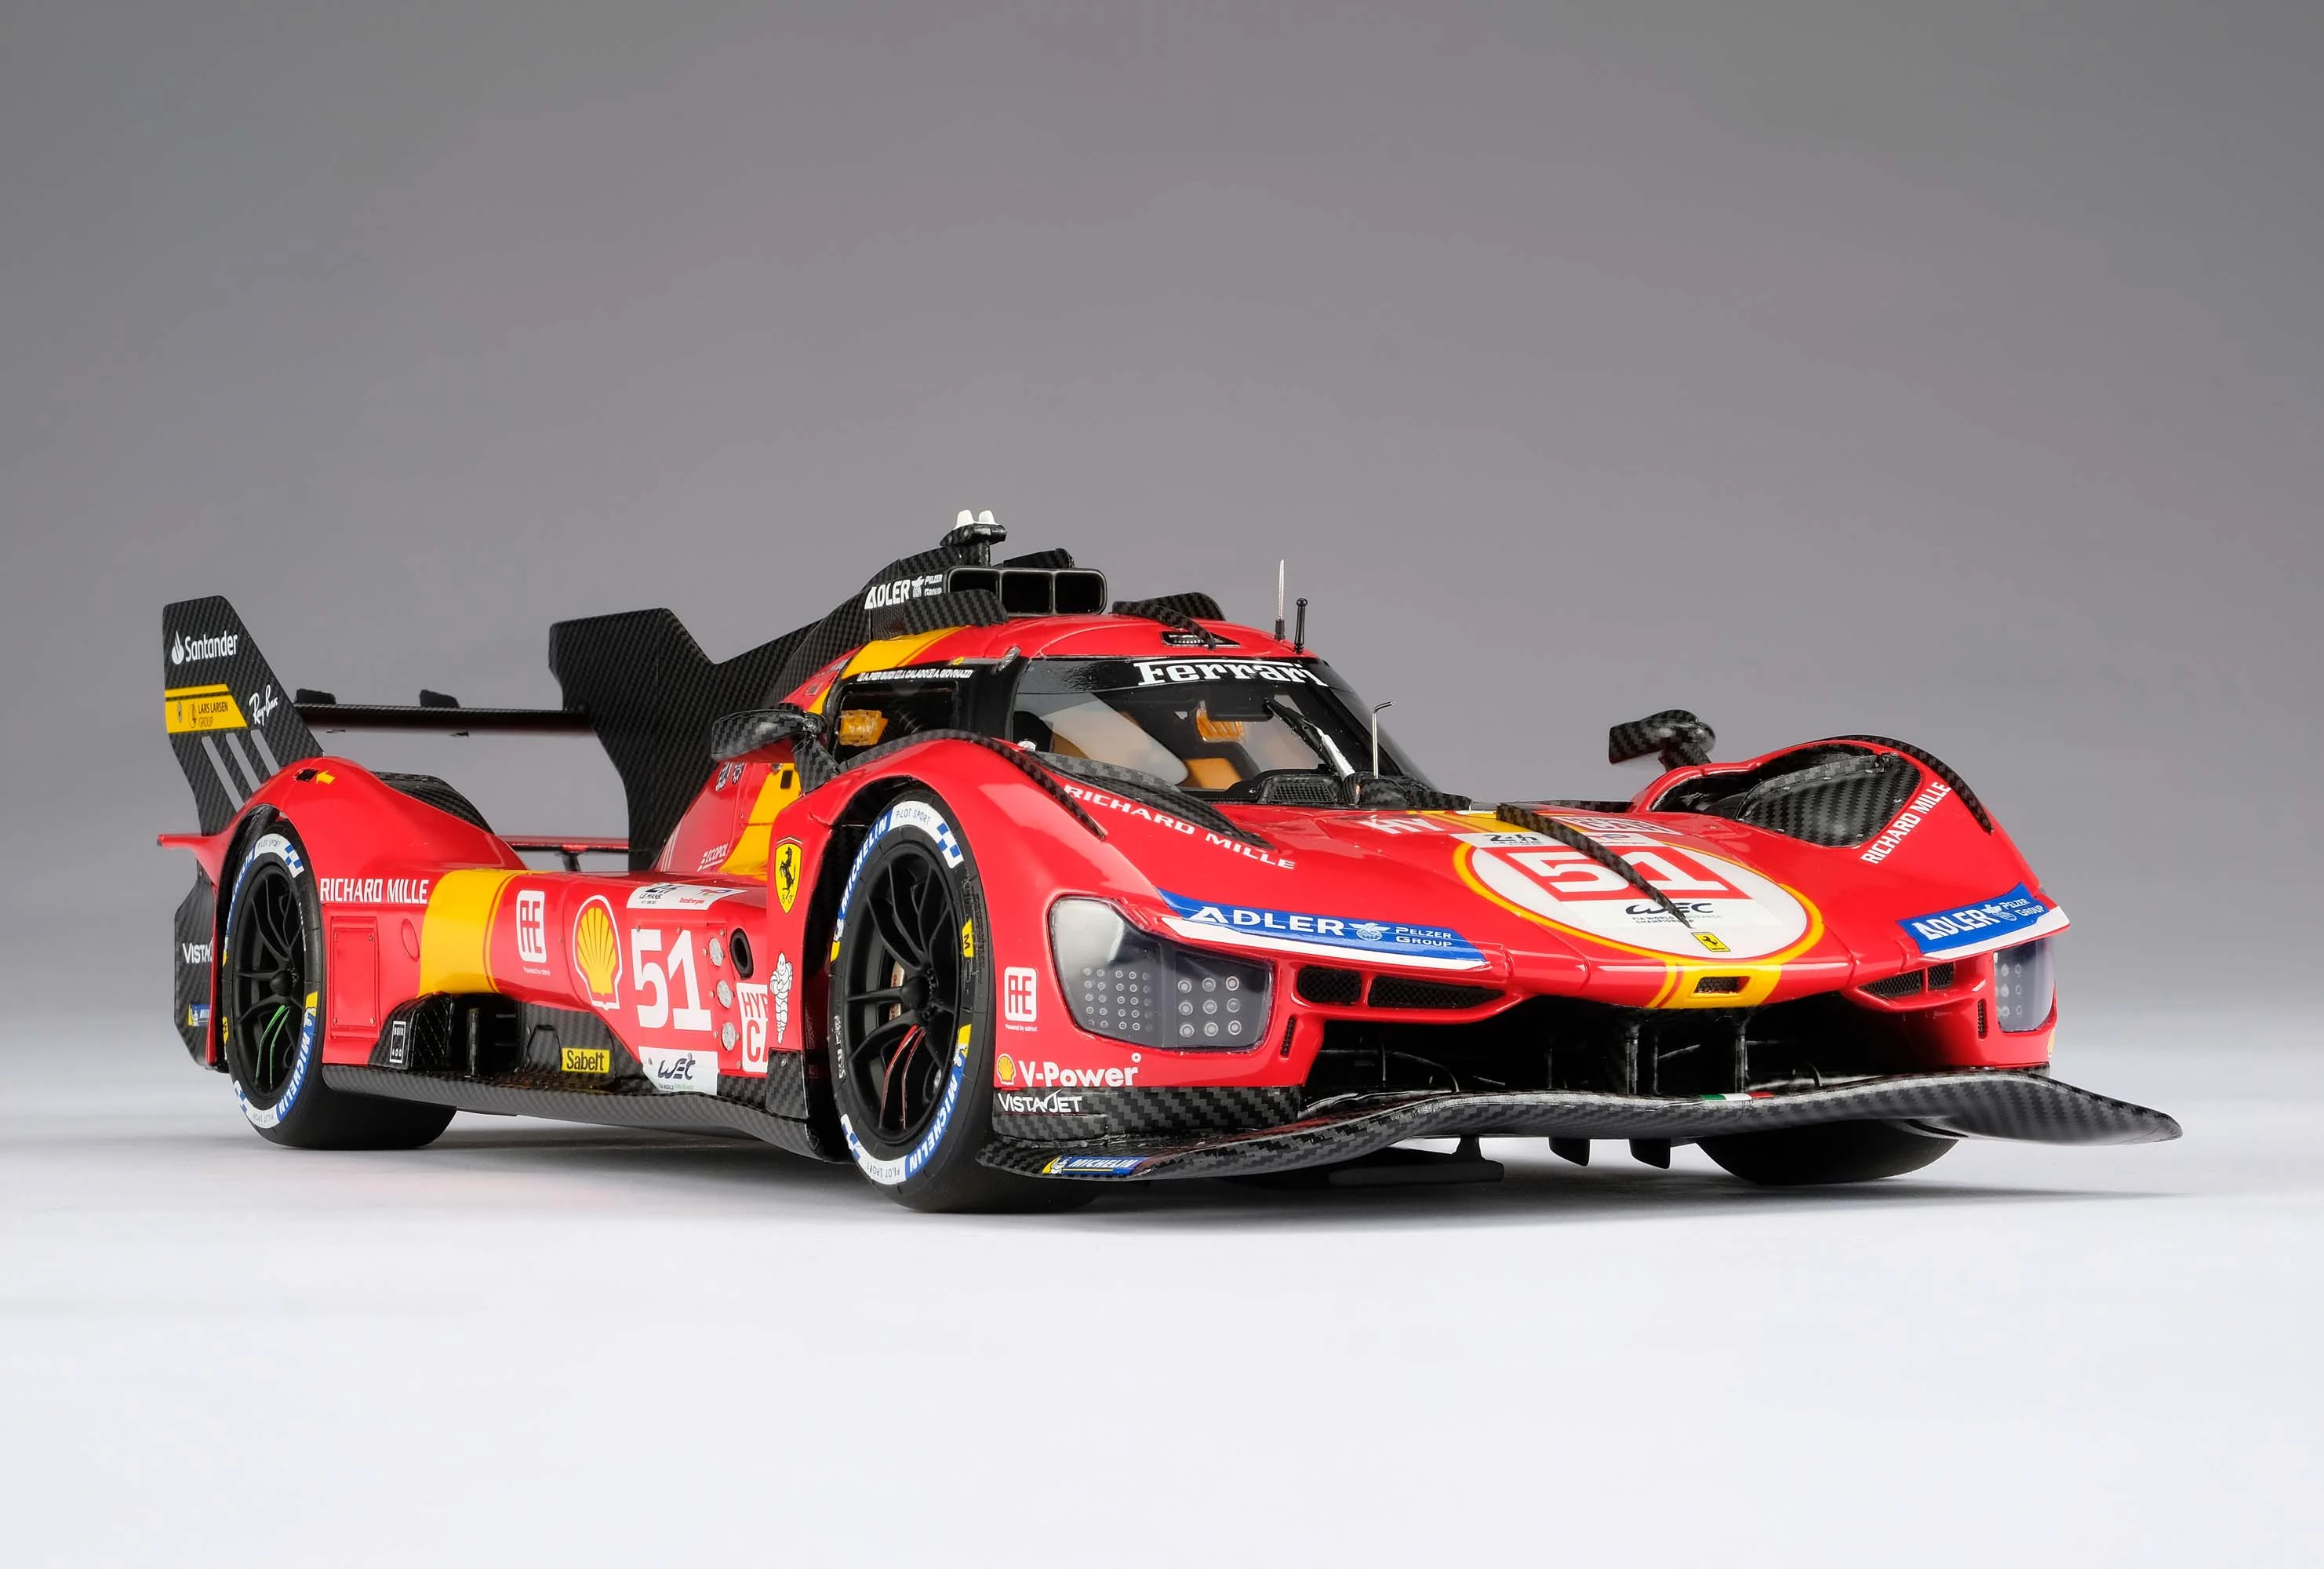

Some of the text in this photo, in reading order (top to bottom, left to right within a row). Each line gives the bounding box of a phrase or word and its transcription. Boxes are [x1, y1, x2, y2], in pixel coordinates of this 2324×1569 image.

[864, 579, 911, 610] ADLER
[184, 630, 238, 662] Santander
[1133, 658, 1329, 688] Ferrari
[198, 701, 228, 714] LARS LARSEN
[1063, 784, 1296, 870] RICHARD MILLE
[1859, 781, 1952, 865] RICHARD MILLE
[1505, 850, 1731, 893] 51
[320, 878, 430, 905] RICHARD MILLE
[1998, 897, 2031, 910] PELZER
[1188, 906, 1344, 937] ADLER
[1911, 908, 2002, 941] ADLER
[2014, 905, 2045, 916] GROUP
[1395, 926, 1452, 939] PELZER
[1395, 936, 1453, 948] GROUP
[631, 928, 712, 1032] 51
[278, 1031, 312, 1116] MICHELIN
[566, 1050, 605, 1072] Sabelt
[657, 1058, 696, 1081] WEC
[1018, 1060, 1139, 1087] V-Power
[909, 1076, 959, 1170] MICHELIN
[1067, 1158, 1139, 1168] MICHELIN
